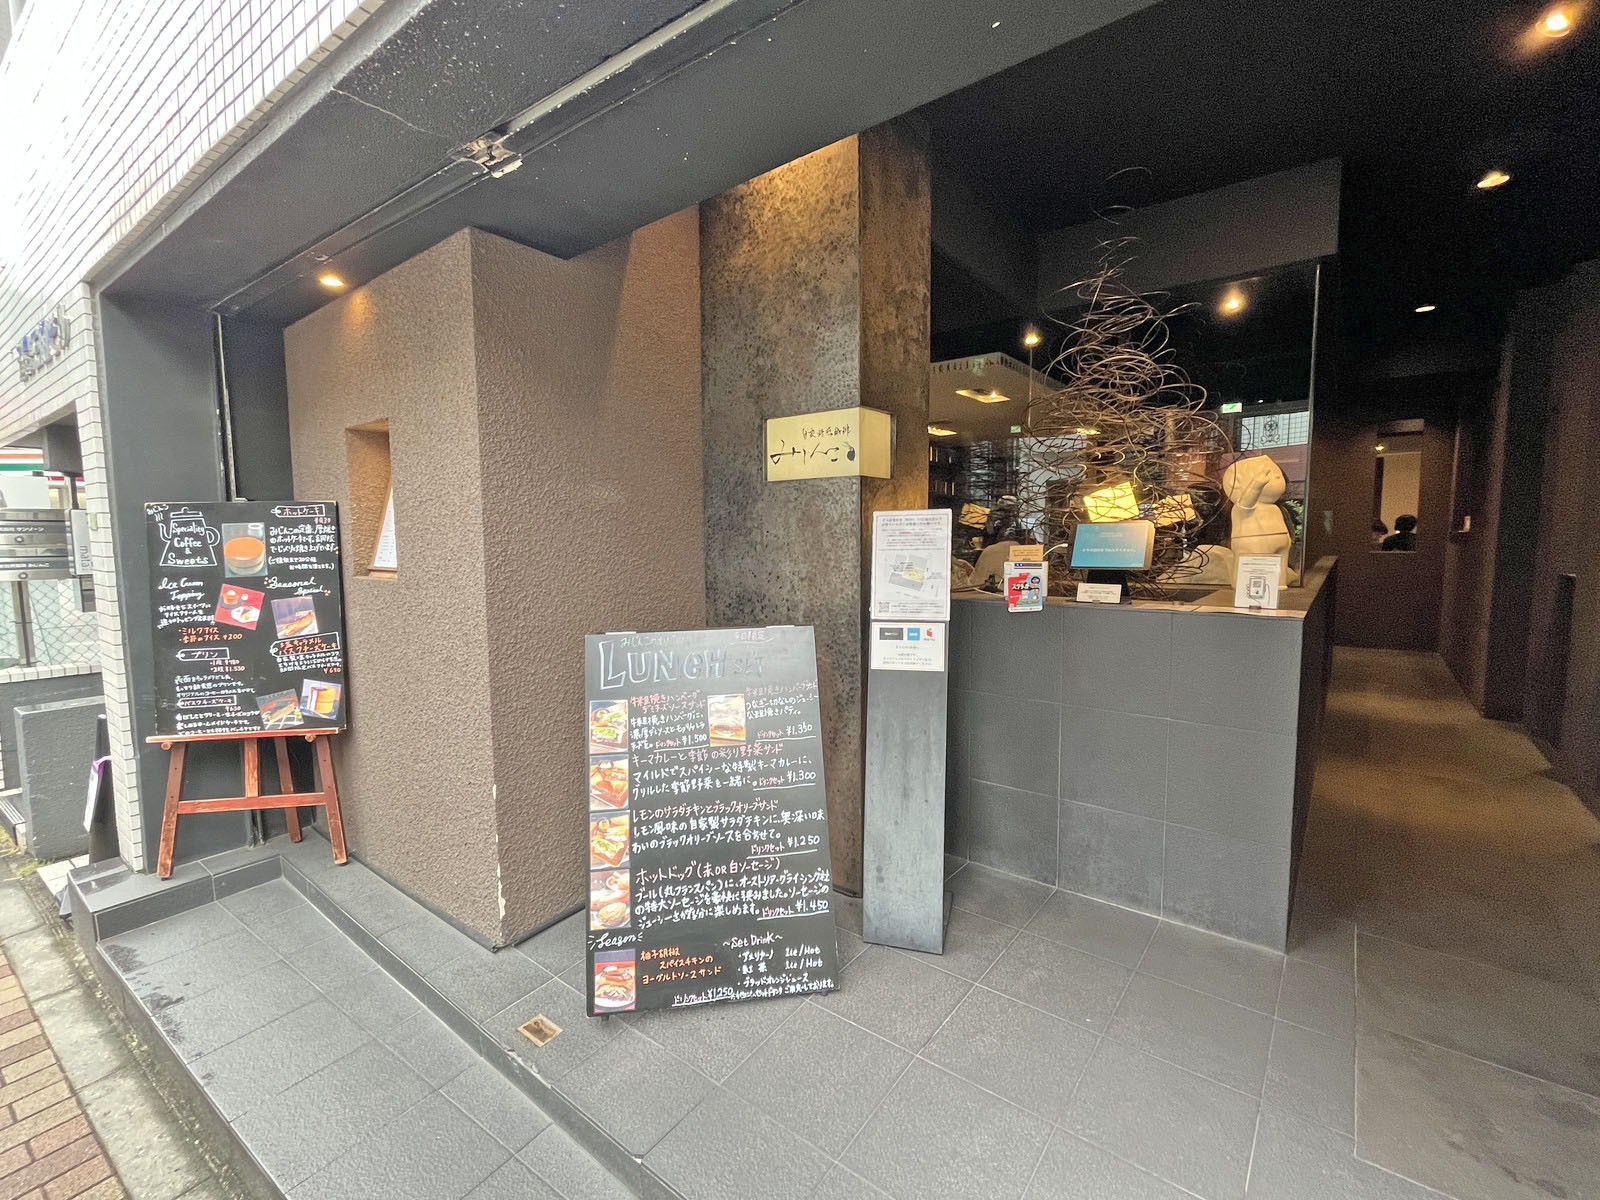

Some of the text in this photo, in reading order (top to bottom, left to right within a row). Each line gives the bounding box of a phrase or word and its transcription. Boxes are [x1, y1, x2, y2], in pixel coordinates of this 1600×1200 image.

[283, 506, 321, 516] ホットケーキ
[174, 537, 203, 547] Coffee
[168, 552, 209, 565] Sweets
[191, 650, 218, 659] プリン
[599, 640, 724, 689] LUNCH
[597, 933, 637, 948] Season
[659, 955, 713, 970] スパイスチキンの
[641, 966, 722, 985] ヨーグルトソースサンド
